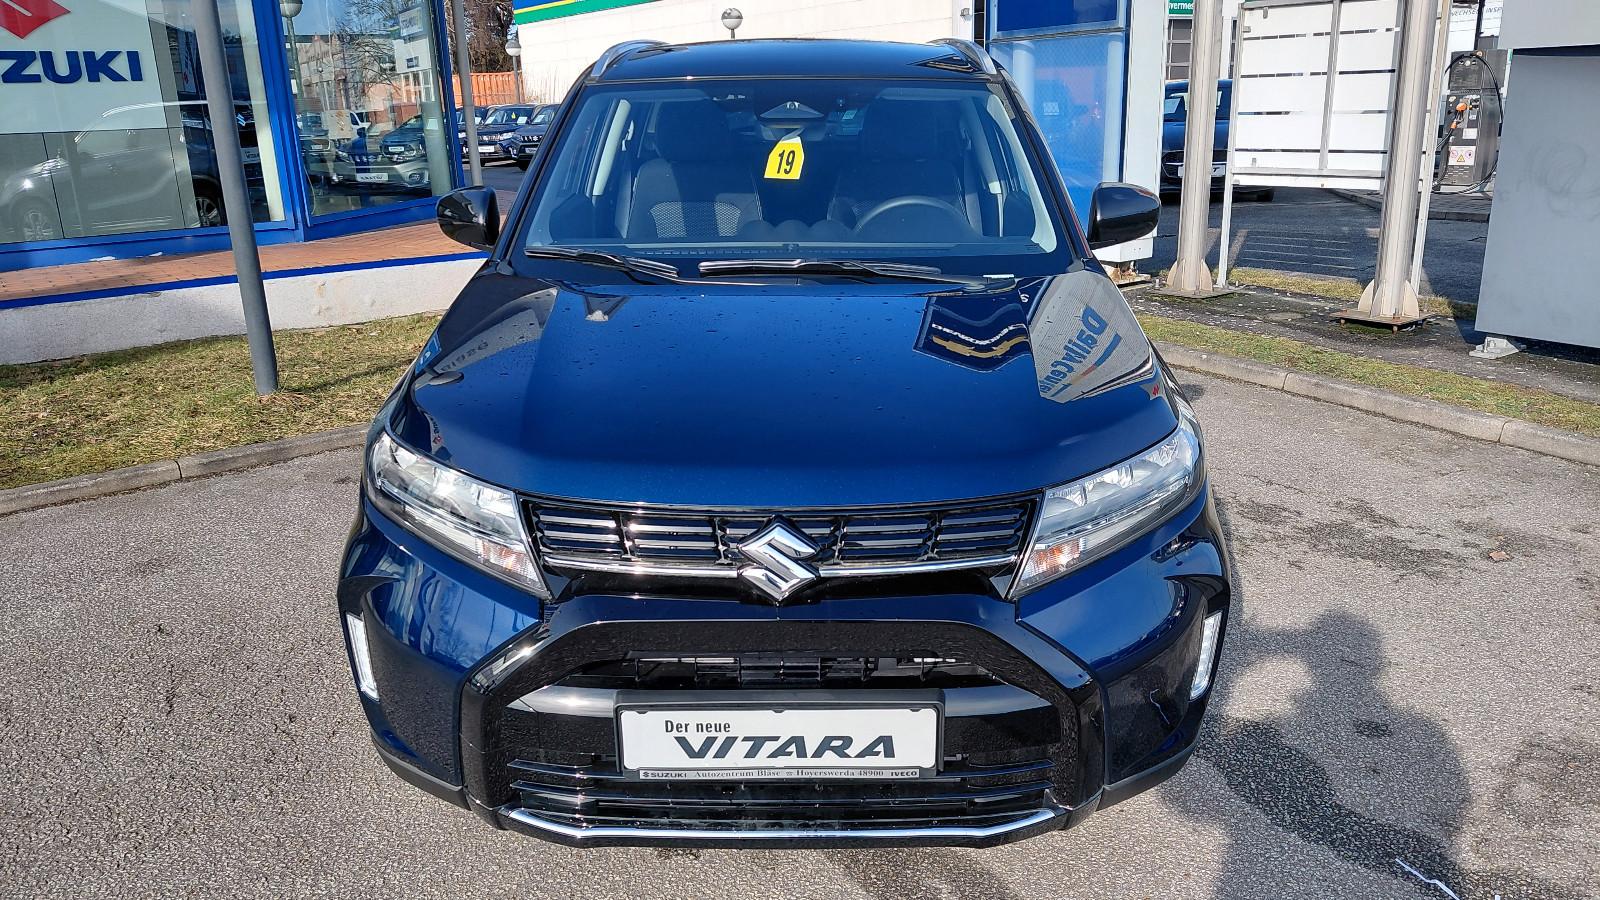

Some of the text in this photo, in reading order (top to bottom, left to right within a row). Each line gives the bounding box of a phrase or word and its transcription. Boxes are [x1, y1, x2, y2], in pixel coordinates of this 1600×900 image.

[0, 50, 144, 84] ZUKI
[777, 149, 796, 175] 19
[664, 719, 732, 734] Der neue
[673, 735, 896, 759] VITARA
[694, 769, 754, 778] Autozentrum
[796, 768, 855, 778] Hoyerswerda
[858, 769, 884, 777] 48900
